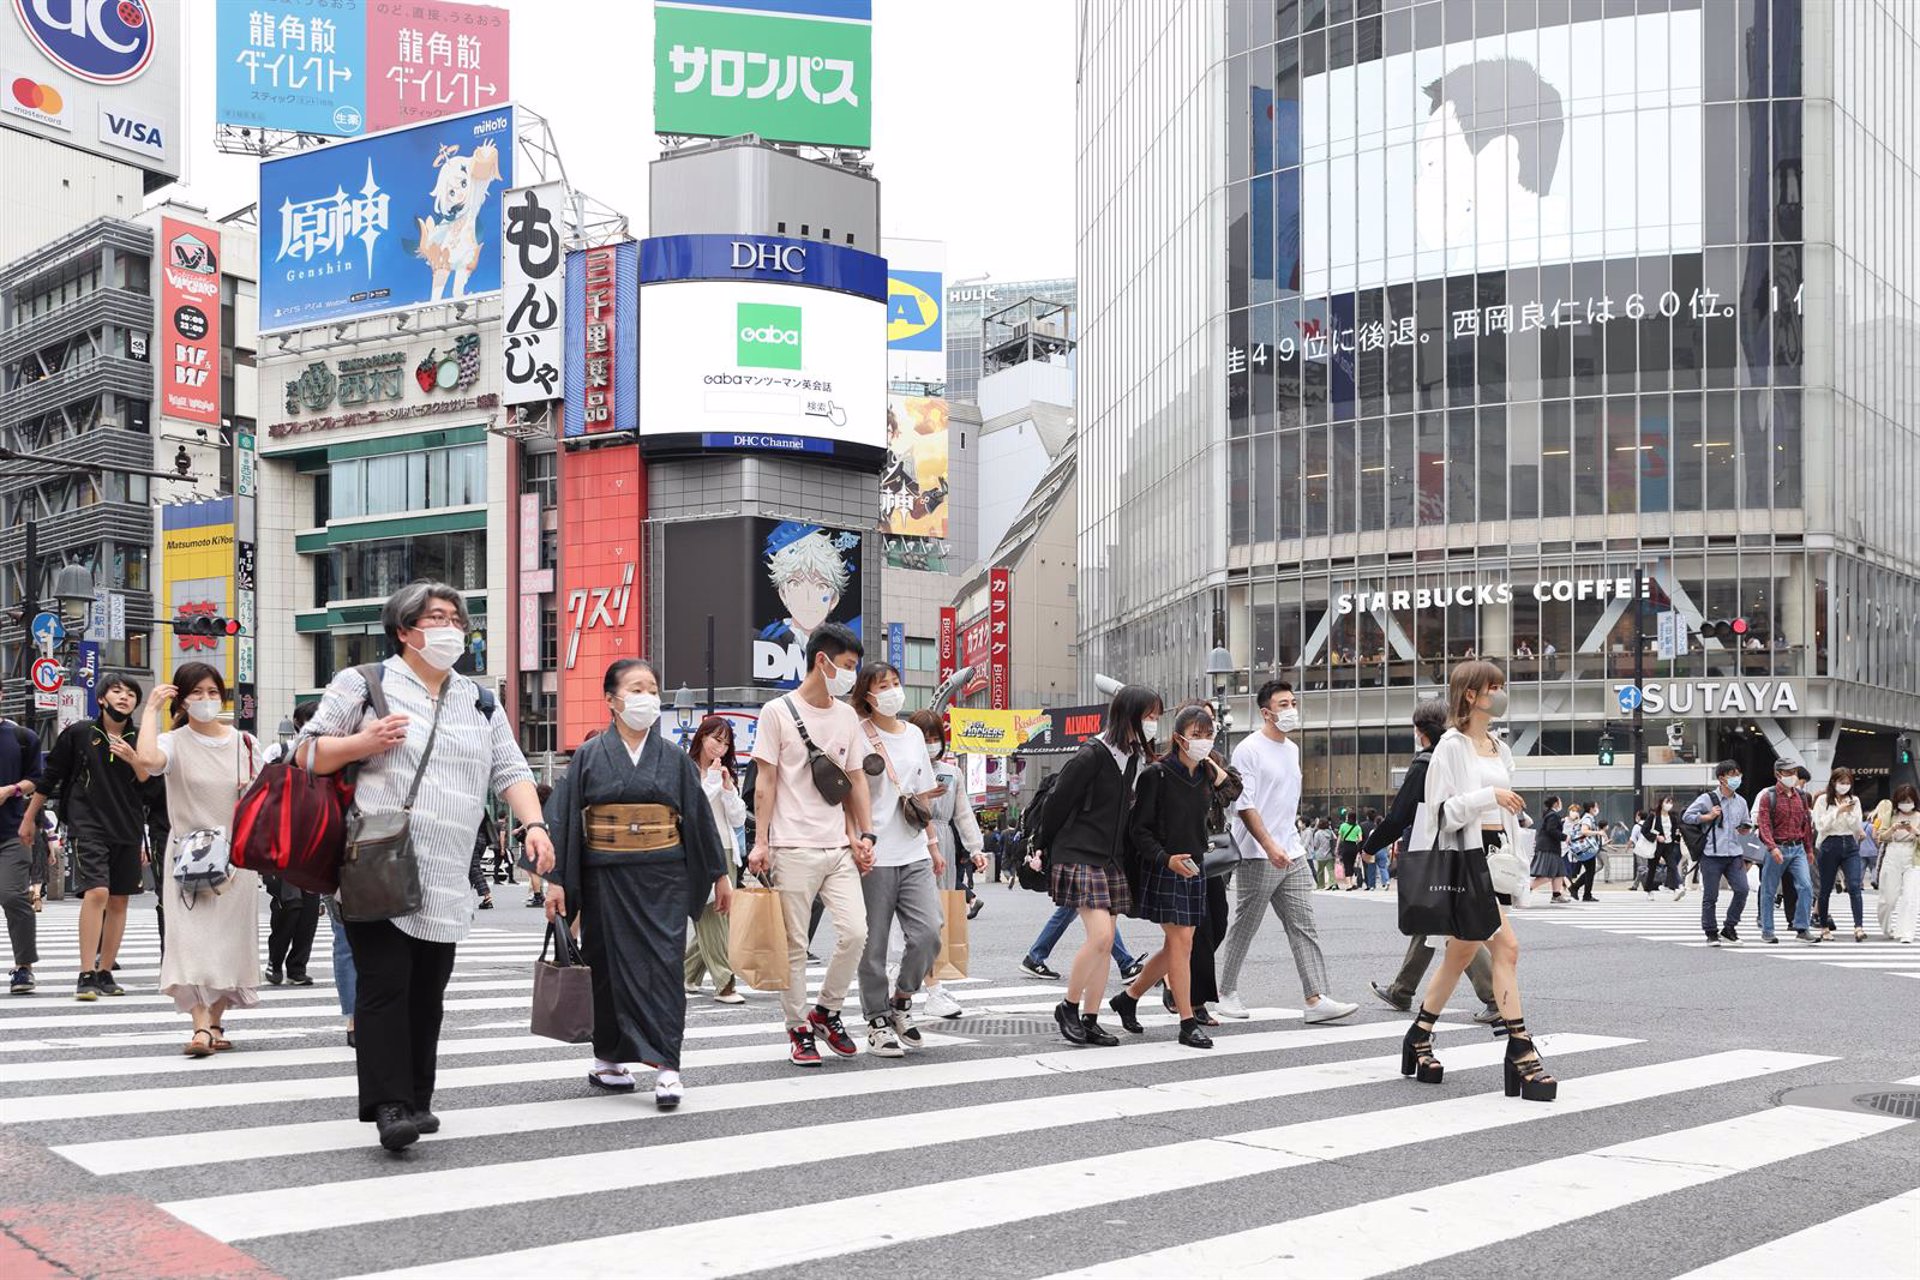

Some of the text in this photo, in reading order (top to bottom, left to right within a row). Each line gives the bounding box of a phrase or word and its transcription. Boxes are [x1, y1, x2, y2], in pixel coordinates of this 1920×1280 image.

[249, 10, 336, 54] 龍角散
[398, 28, 481, 70] 龍角散
[236, 49, 352, 93] ダイレクト
[386, 66, 497, 108] ダイレクト
[669, 44, 858, 107] サロンパス
[14, 105, 62, 126] mastercard
[103, 112, 163, 148] VISA
[275, 157, 391, 280] 原神
[286, 260, 353, 282] Genshin
[731, 241, 806, 273] DHC
[506, 190, 559, 395] もんじゃ
[175, 343, 208, 365] B1F
[585, 252, 610, 422] 三千里薬品
[175, 365, 208, 388] B2F
[734, 435, 804, 449] DHC Channel
[880, 479, 914, 528] 神
[167, 539, 211, 550] Matsumoto
[566, 562, 635, 669] クスリ
[992, 579, 1007, 654] カラオケ
[1337, 583, 1513, 614] STARBUCKS
[753, 640, 807, 681] DM
[1065, 713, 1101, 735] ALVARK
